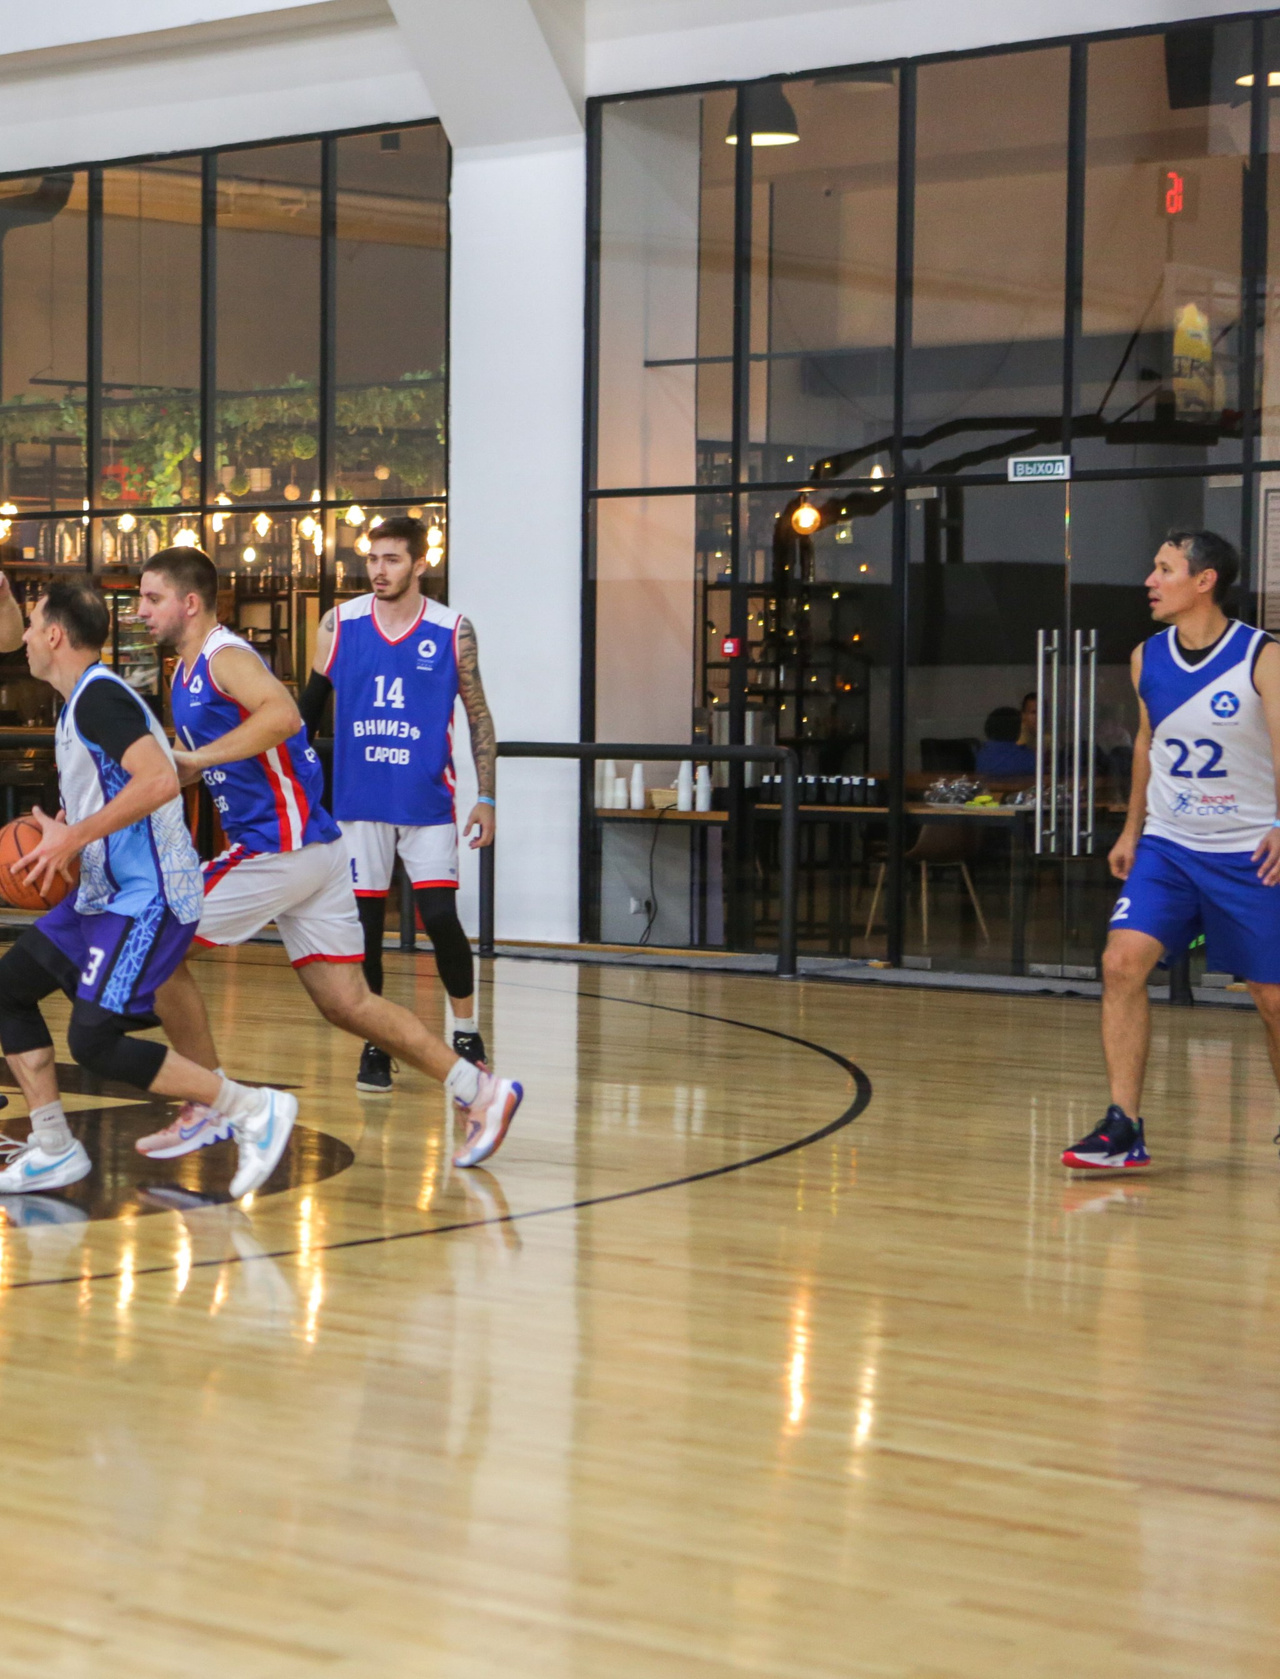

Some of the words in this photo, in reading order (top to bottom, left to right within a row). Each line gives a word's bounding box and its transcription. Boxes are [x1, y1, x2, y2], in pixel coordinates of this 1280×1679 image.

[1015, 461, 1065, 477] ВЫХОД
[373, 675, 405, 709] 14
[353, 719, 421, 741] ВНИИЭФ
[364, 746, 411, 765] САРОВ
[1164, 738, 1228, 779] 22
[1109, 897, 1131, 922] 2
[81, 946, 106, 987] 3
